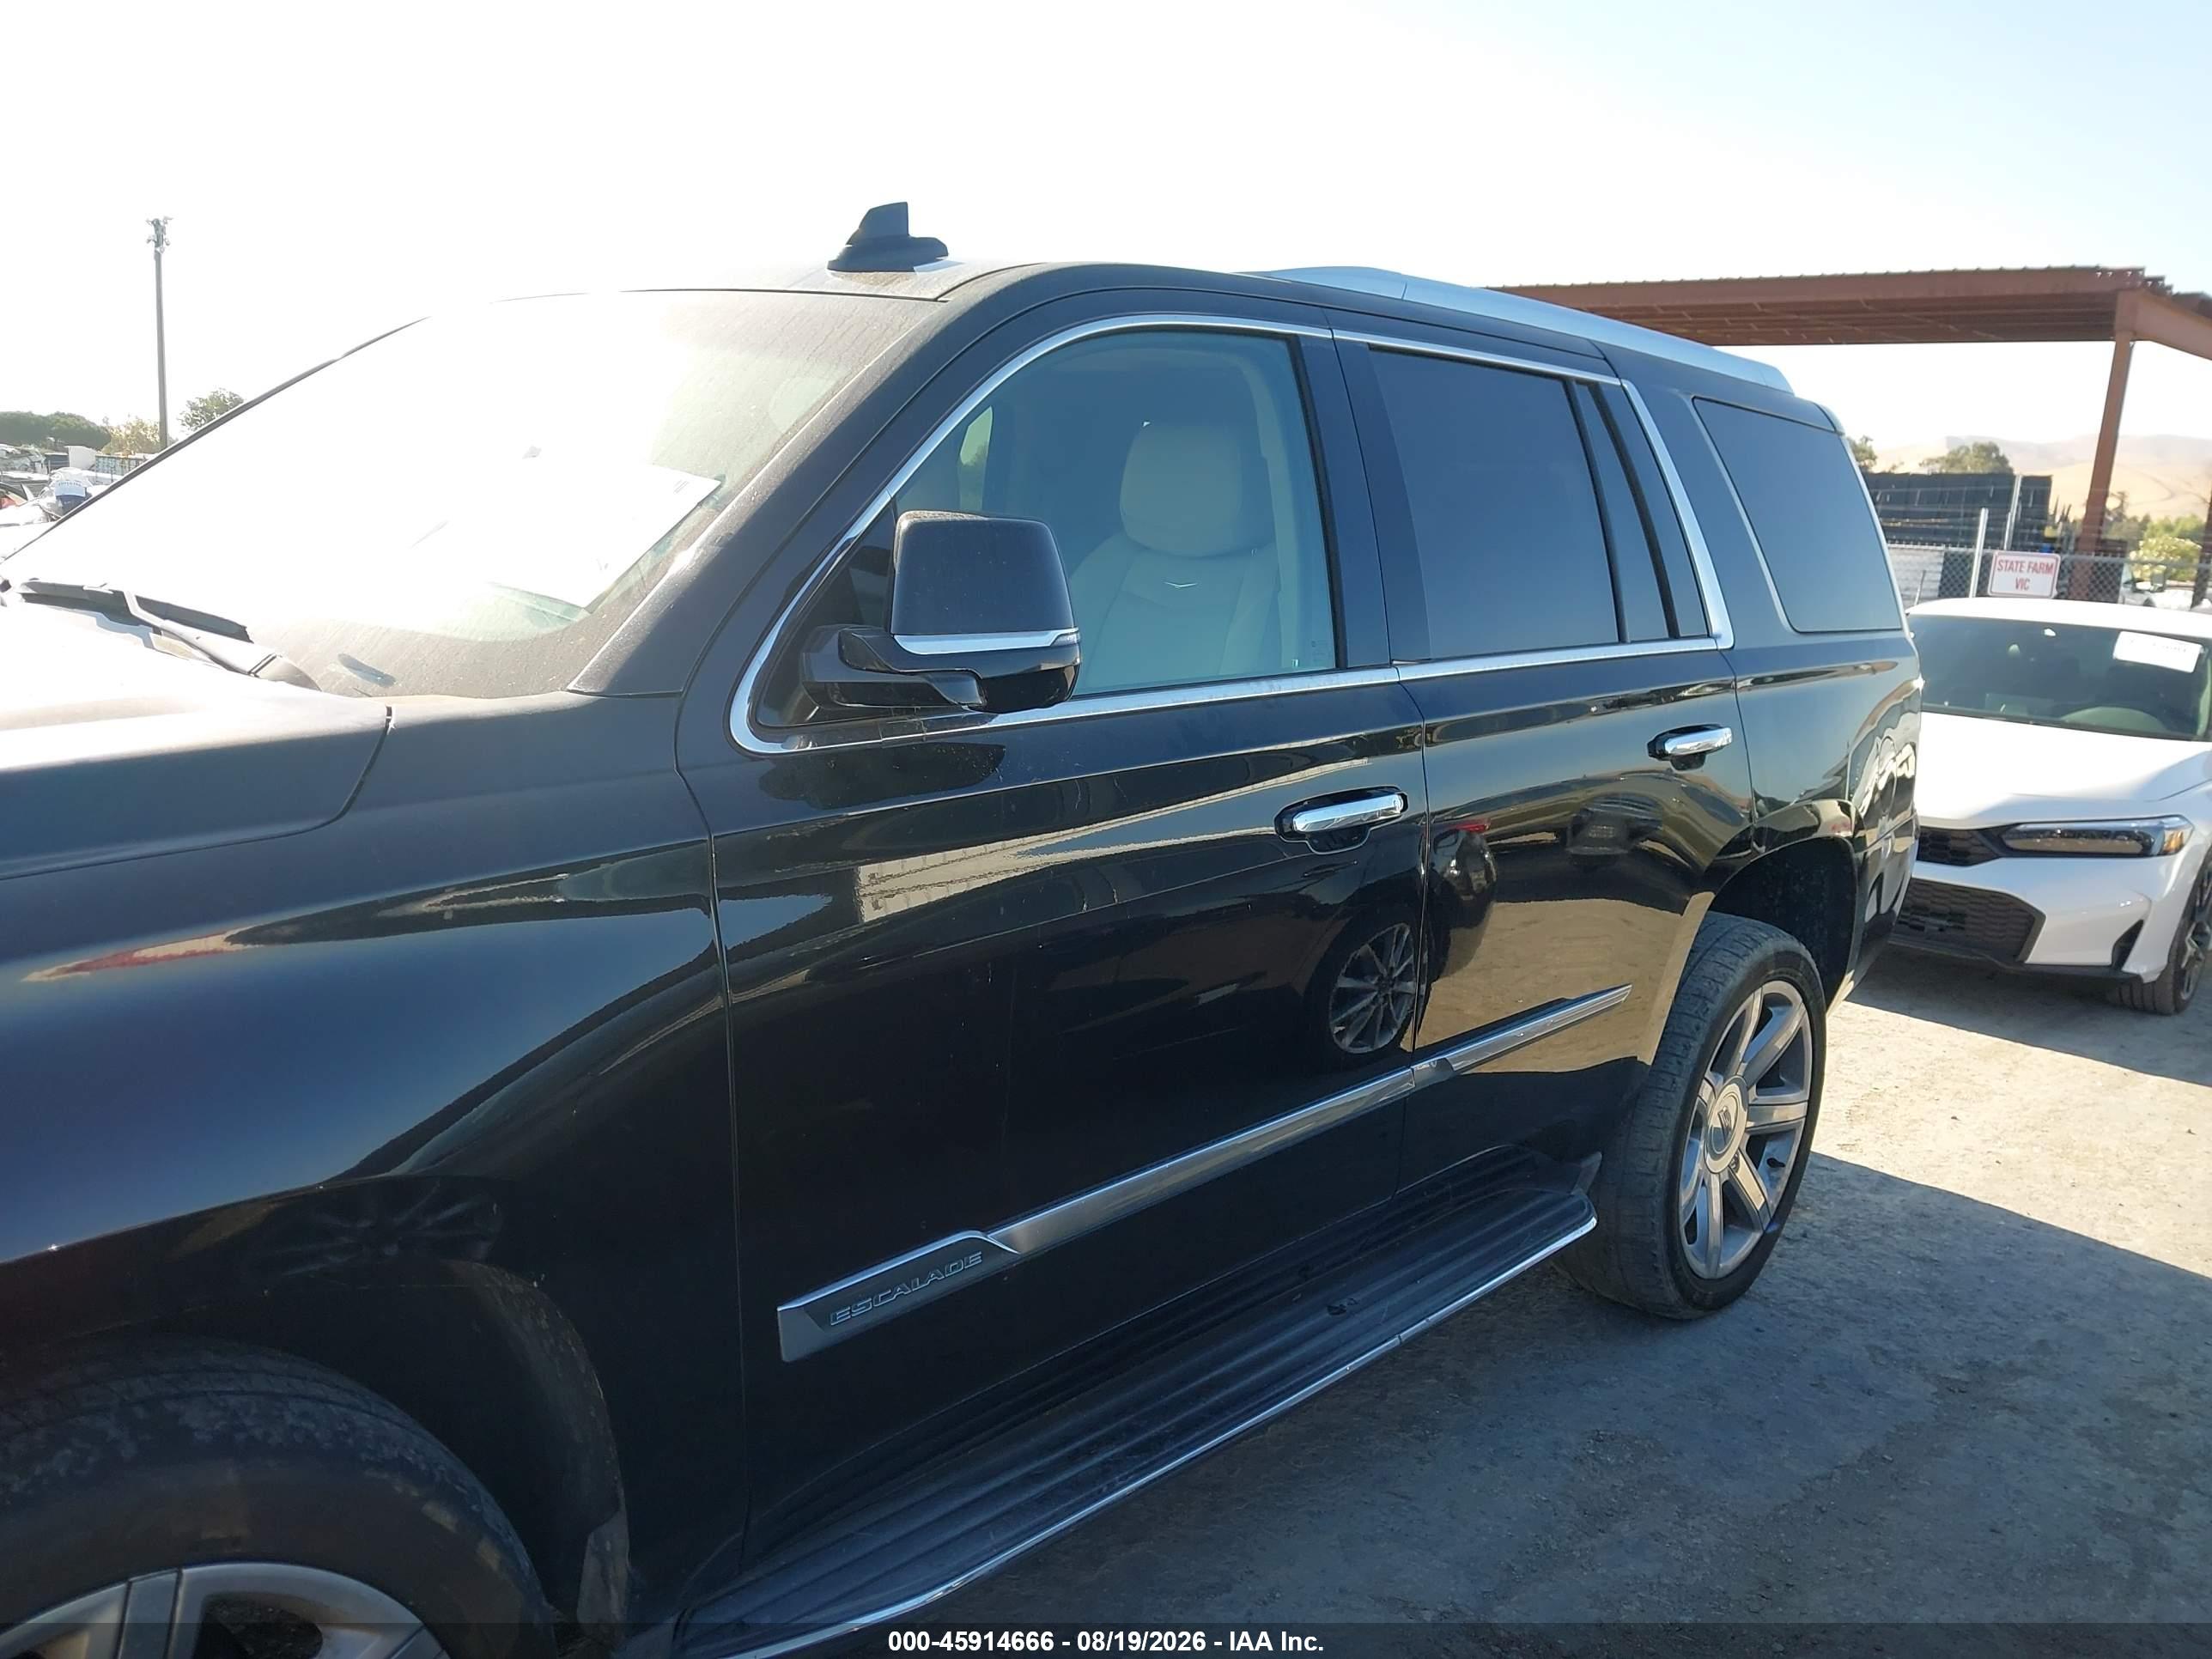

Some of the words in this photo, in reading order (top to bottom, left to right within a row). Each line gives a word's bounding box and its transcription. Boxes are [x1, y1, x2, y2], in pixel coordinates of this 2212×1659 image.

[1997, 559, 2025, 573] STATE
[2027, 561, 2054, 574] FARM
[2015, 577, 2030, 590] VIC
[830, 1251, 982, 1325] ESCALADE
